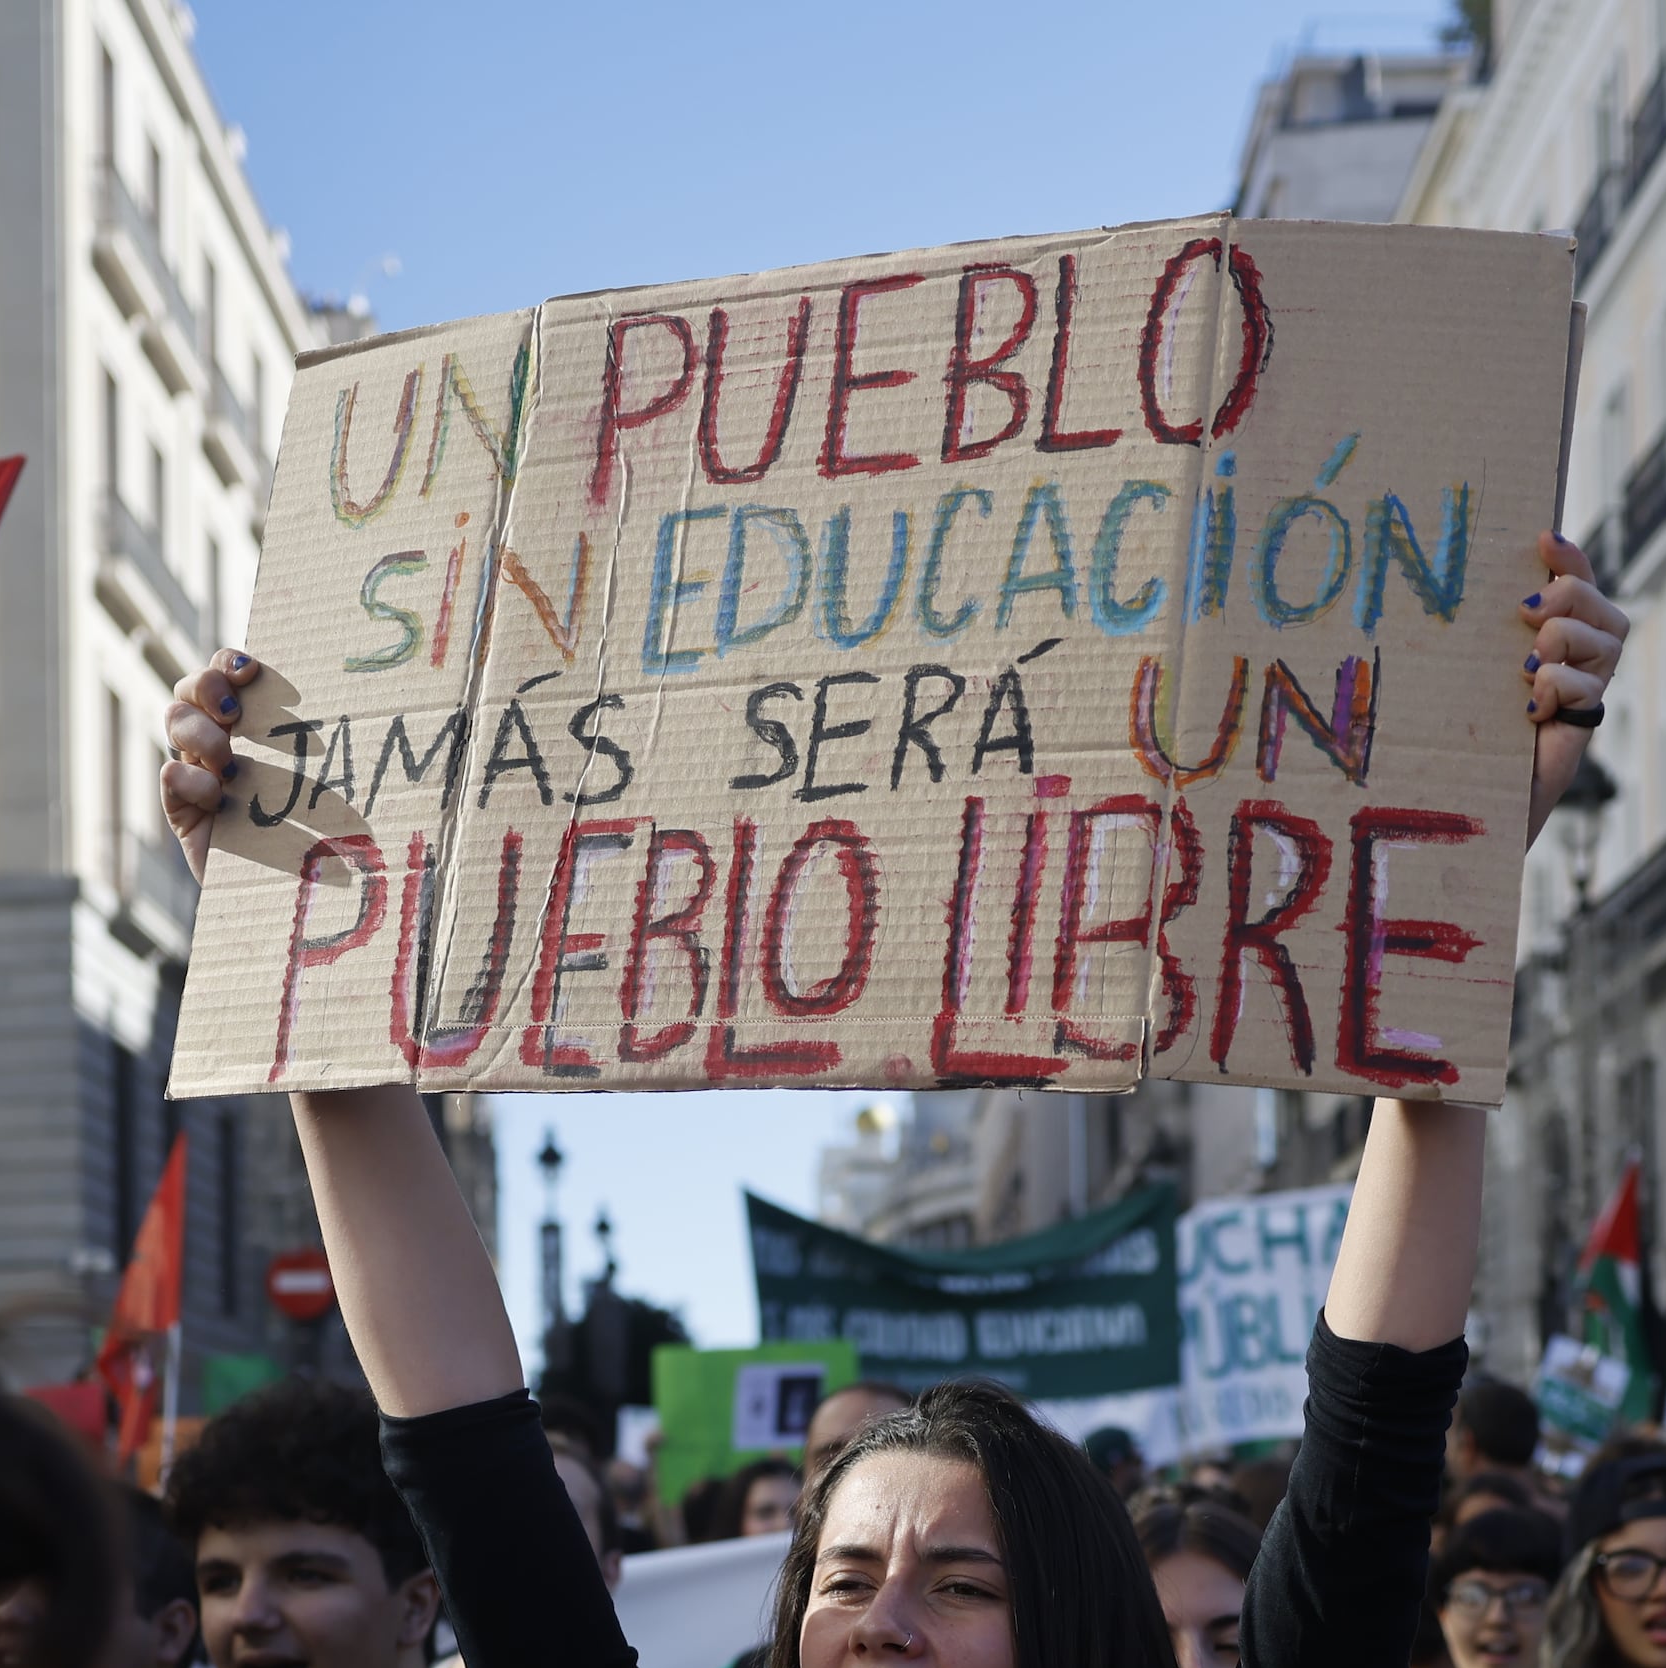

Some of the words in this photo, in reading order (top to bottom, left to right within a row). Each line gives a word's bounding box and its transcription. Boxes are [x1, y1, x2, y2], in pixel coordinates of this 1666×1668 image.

[330, 340, 535, 530] UN
[585, 236, 1275, 514] PUEBLO
[248, 670, 635, 829] JAMÁS
[729, 636, 1066, 800] SERÁ
[1128, 642, 1383, 790] UN
[266, 812, 882, 1088] PUEBLO
